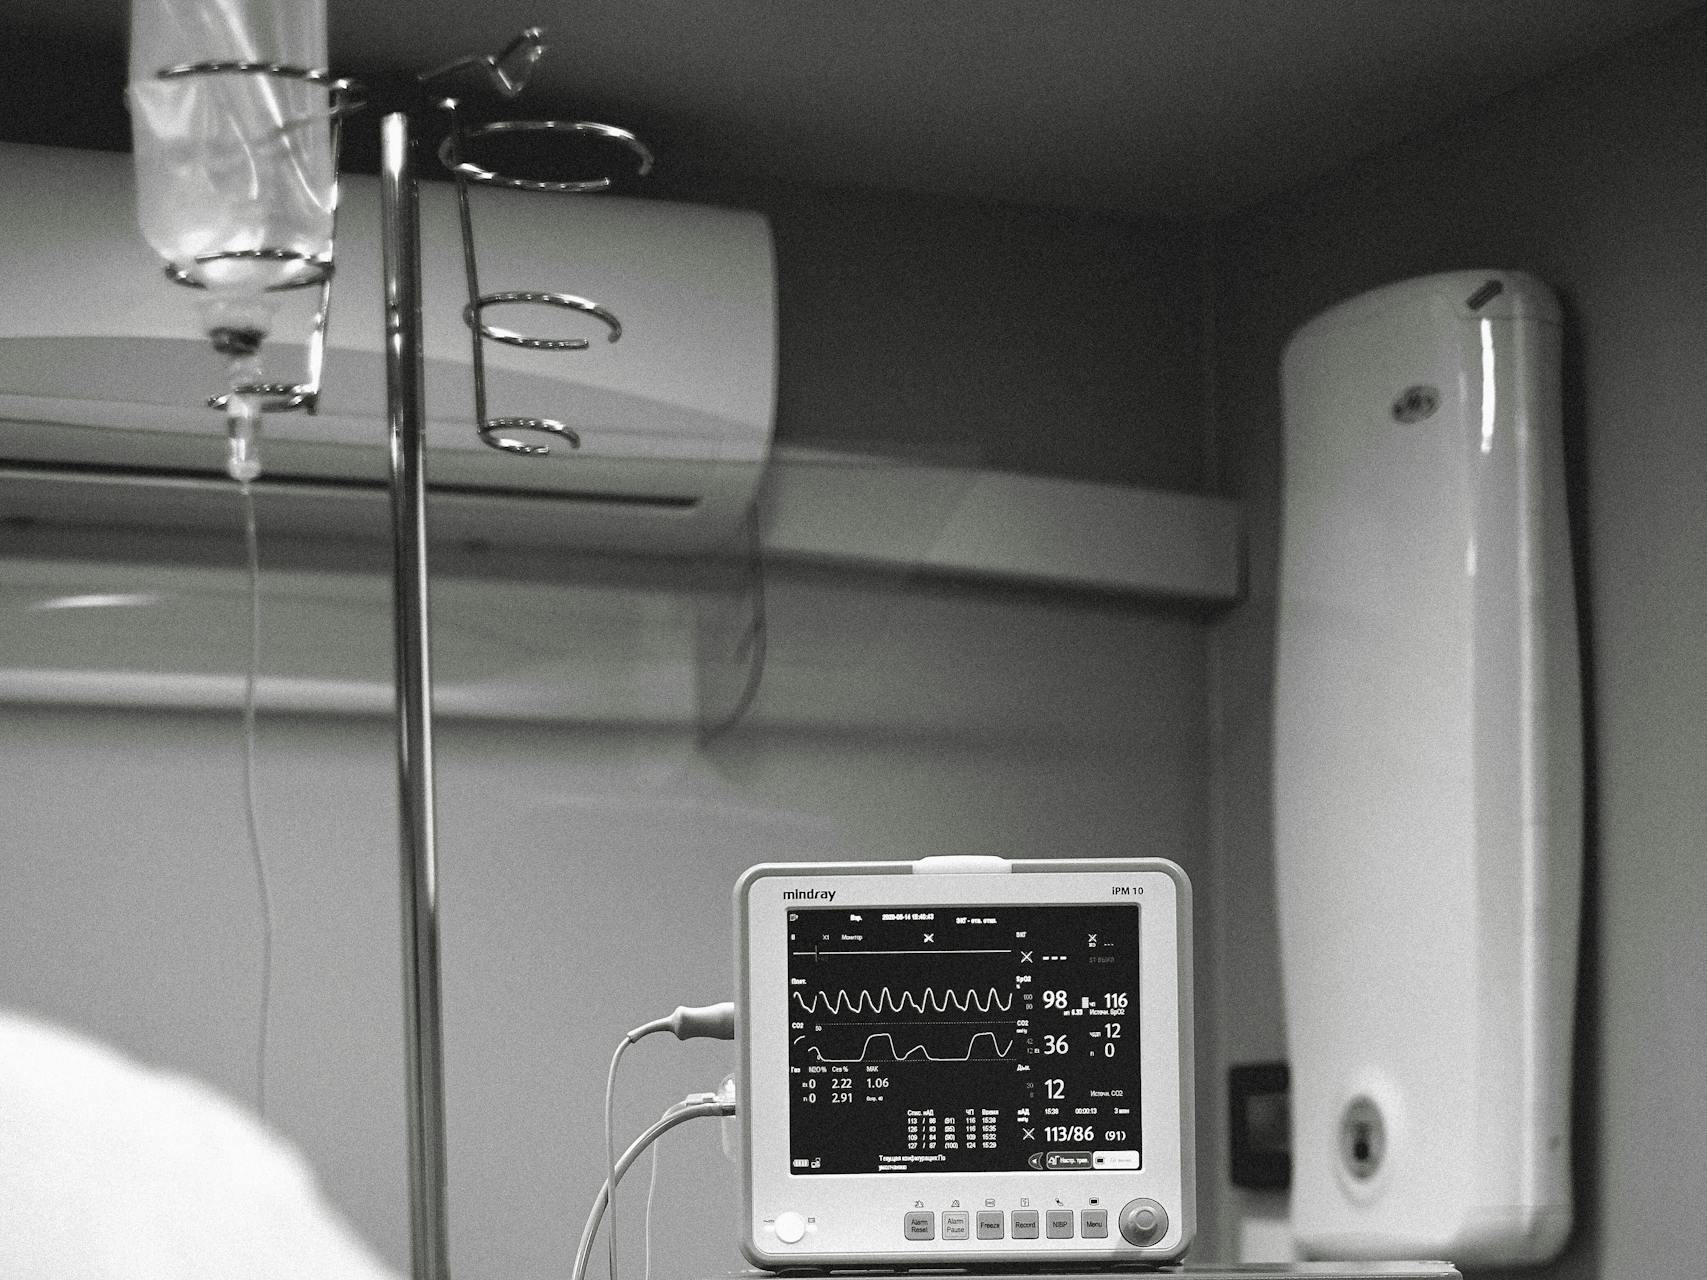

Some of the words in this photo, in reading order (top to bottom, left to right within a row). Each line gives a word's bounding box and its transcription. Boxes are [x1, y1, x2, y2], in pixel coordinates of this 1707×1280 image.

[783, 888, 836, 902] mindray
[1112, 886, 1130, 895] iPM
[1133, 886, 1144, 895] 10
[1043, 990, 1068, 1009] 98
[1104, 992, 1128, 1008] 116
[1104, 1023, 1121, 1038] 12
[1043, 1035, 1069, 1055] 36
[1104, 1043, 1115, 1058] 0
[808, 1078, 817, 1089] 0
[831, 1078, 852, 1089] 2.22
[866, 1077, 889, 1089] 1.06
[1044, 1079, 1065, 1100] 12
[808, 1093, 817, 1103] 0
[831, 1092, 853, 1103] 2.91
[1044, 1126, 1095, 1142] 113/86
[1105, 1130, 1127, 1141] (91)
